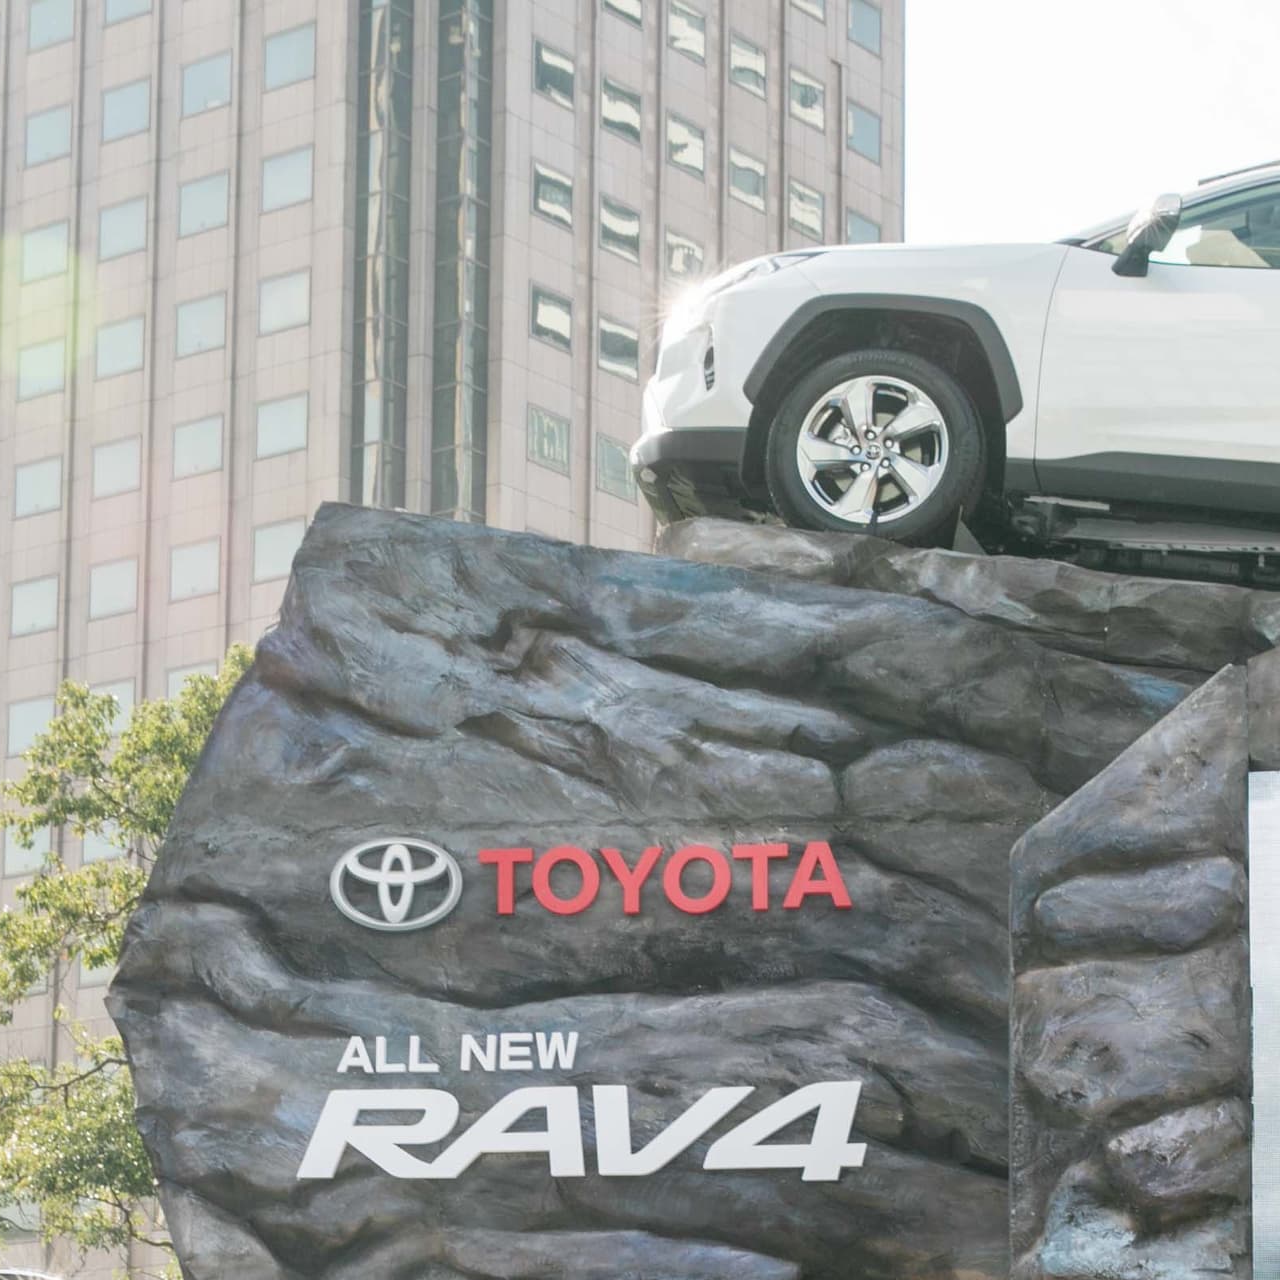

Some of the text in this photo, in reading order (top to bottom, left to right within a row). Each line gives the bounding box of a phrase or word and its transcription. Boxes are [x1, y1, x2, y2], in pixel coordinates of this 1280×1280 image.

[478, 841, 852, 915] TOYOTA
[336, 1031, 579, 1074] ALL NEW
[296, 1080, 867, 1182] RAV4
